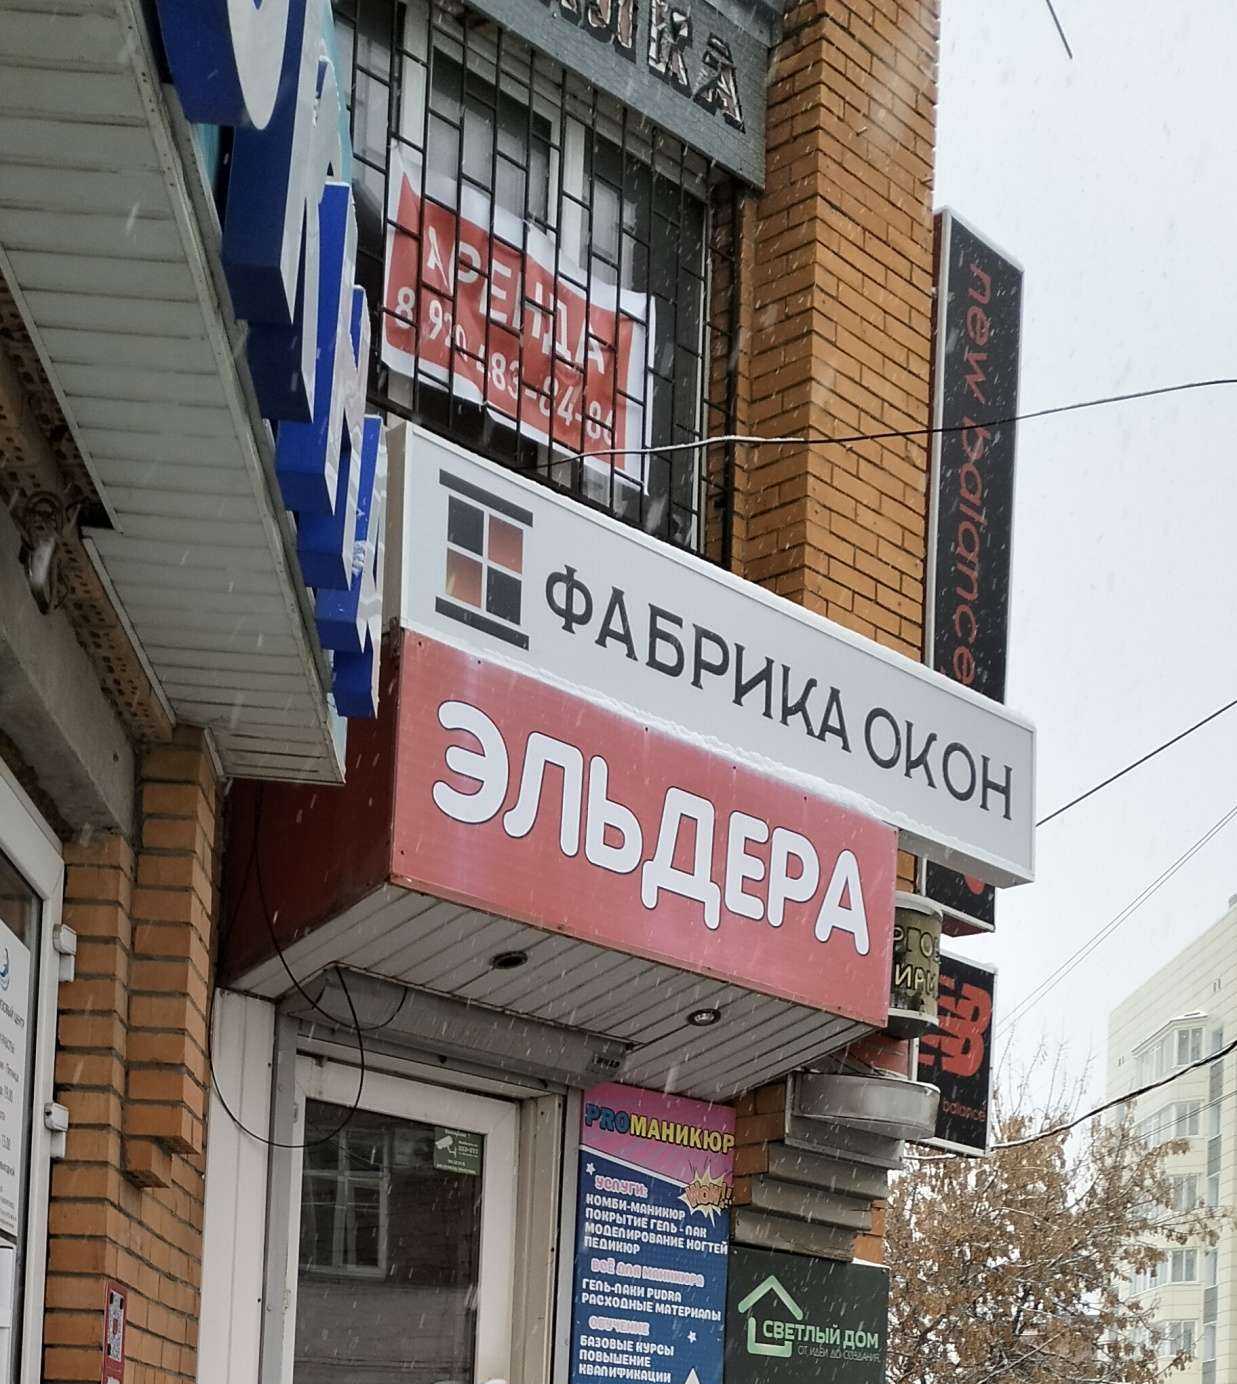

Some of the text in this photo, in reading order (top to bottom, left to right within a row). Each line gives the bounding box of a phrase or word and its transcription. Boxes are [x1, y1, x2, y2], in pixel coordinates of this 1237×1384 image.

[397, 286, 416, 330] 8
[424, 225, 605, 374] АРЕНДА
[952, 263, 992, 685] new balance
[545, 564, 1014, 820] ФАБРИКА ОКОН
[431, 700, 871, 956] ЭЛЬДЕРА
[586, 1193, 686, 1221] КОМБИ-МАНИКЮР
[585, 1207, 648, 1229] ПОКРЫТИЕ
[650, 1220, 677, 1234] ГЕЛЬ
[685, 1225, 707, 1238] ЛАК
[583, 1235, 640, 1254] ПЕДИКЮР
[584, 1222, 728, 1255] МОДЕЛИРОВАНИЕ НОГТЕЙ
[582, 1278, 682, 1302] ГЕЛЬ-ЛАКИ PUDRA
[581, 1292, 721, 1321] РАСХОДНЫЕ МАТЕРИАЛЫ
[580, 1335, 674, 1356] БАЗОВЫЕ КУРСЫ
[762, 1319, 879, 1350] СВЕТЛЫЙ ДОМ
[579, 1349, 650, 1368] ПОВЫШЕНИЕ
[797, 1345, 808, 1355] ОТ
[578, 1364, 672, 1384] КВАЛИФИКАЦИИ
